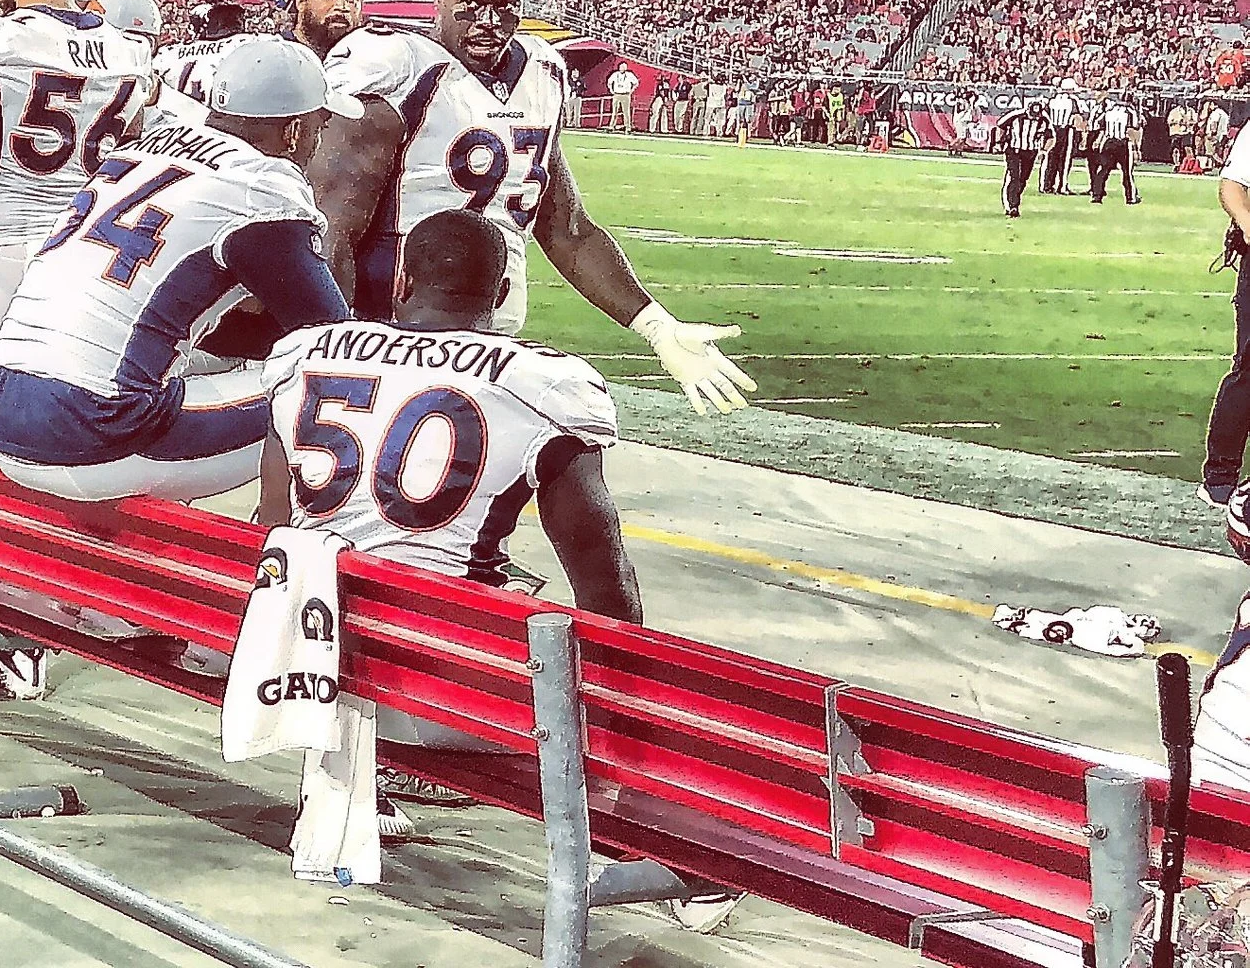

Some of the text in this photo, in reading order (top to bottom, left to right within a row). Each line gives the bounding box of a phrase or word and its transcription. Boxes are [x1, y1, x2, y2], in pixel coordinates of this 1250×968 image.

[67, 39, 108, 70] RAY
[8, 69, 138, 176] 56
[486, 111, 525, 119] BRONCOS
[898, 89, 989, 110] ARIZOA
[130, 124, 239, 171] ARSHALL
[445, 125, 553, 231] 93
[34, 157, 196, 290] 54
[305, 328, 517, 383] ANDERSON
[288, 370, 489, 533] 50
